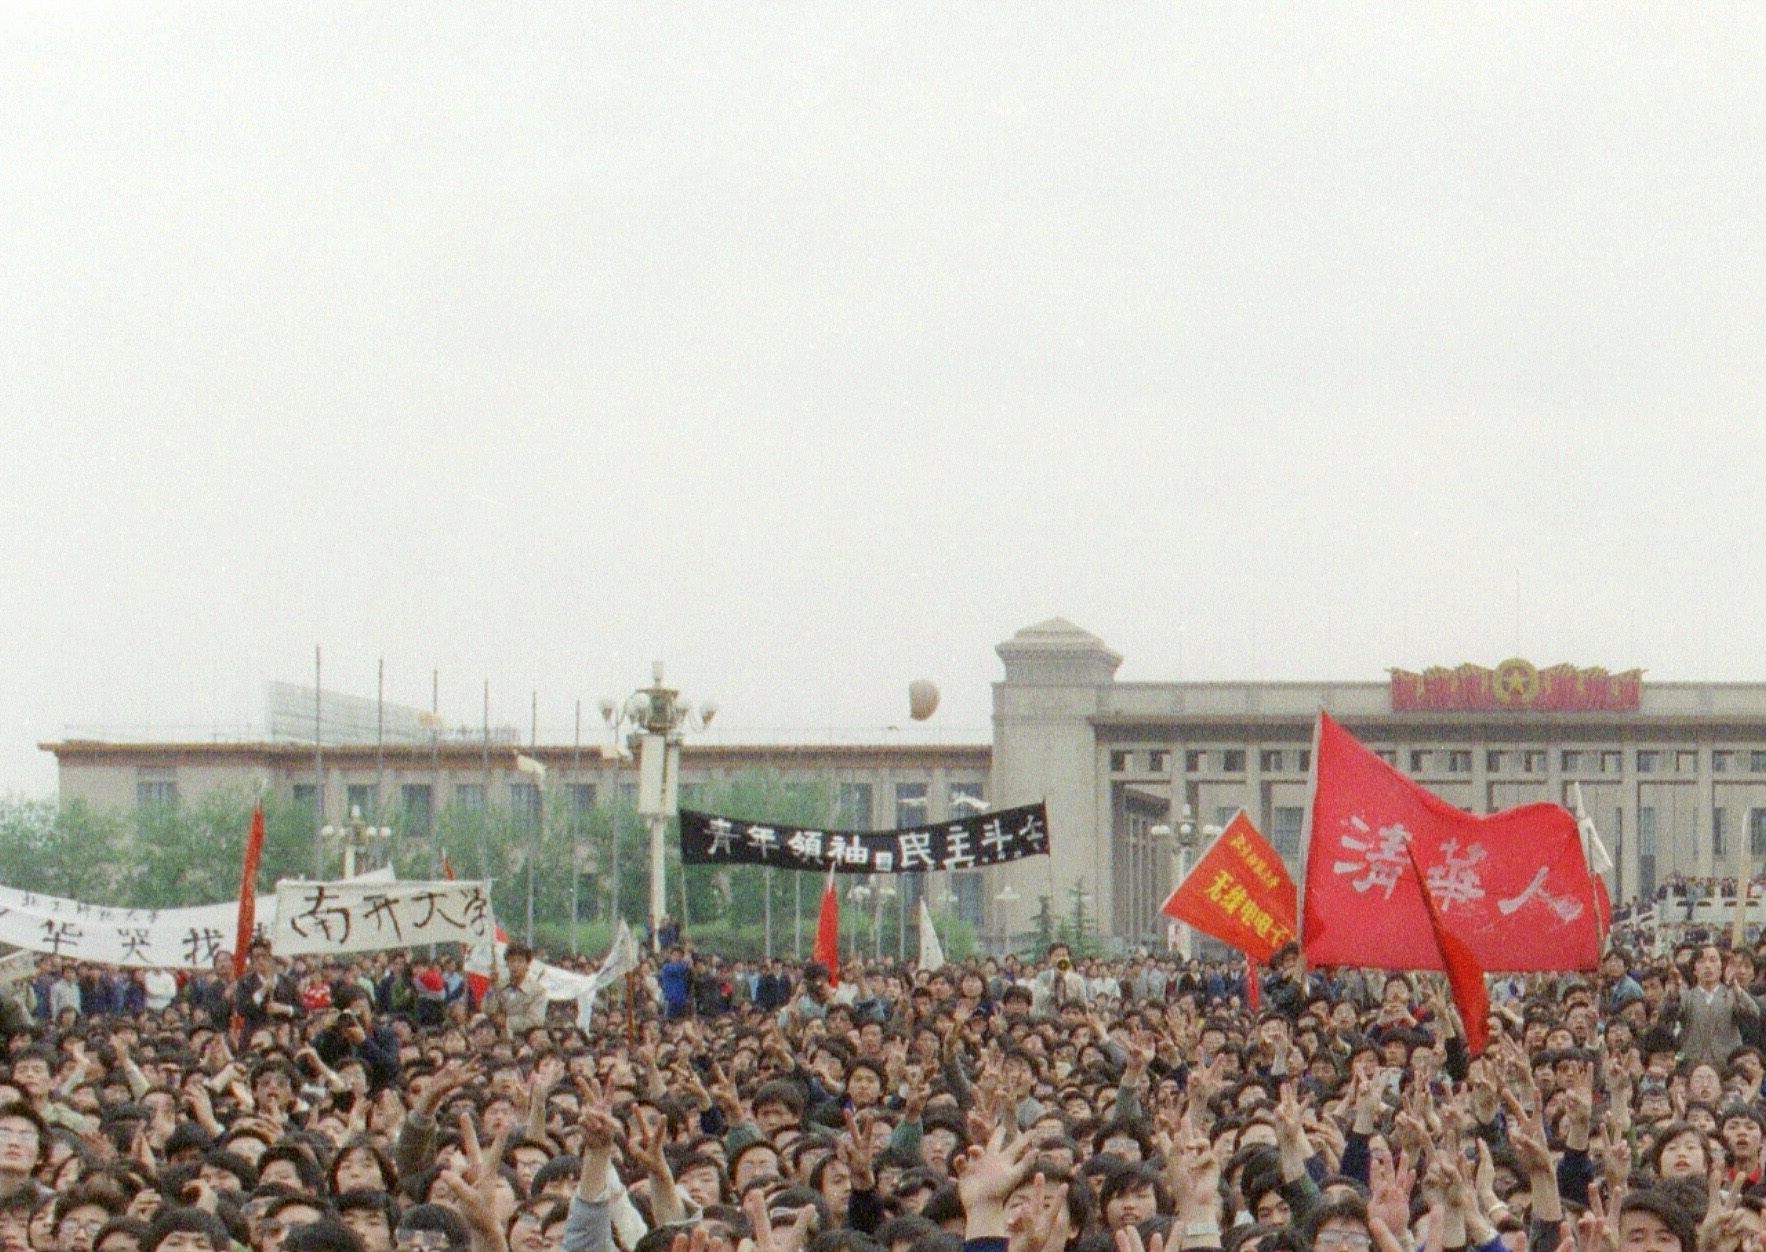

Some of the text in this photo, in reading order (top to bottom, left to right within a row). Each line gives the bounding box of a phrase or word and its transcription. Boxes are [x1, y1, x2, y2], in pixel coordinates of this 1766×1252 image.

[291, 886, 487, 944] 南开大学
[1203, 868, 1297, 948] 无线电电子
